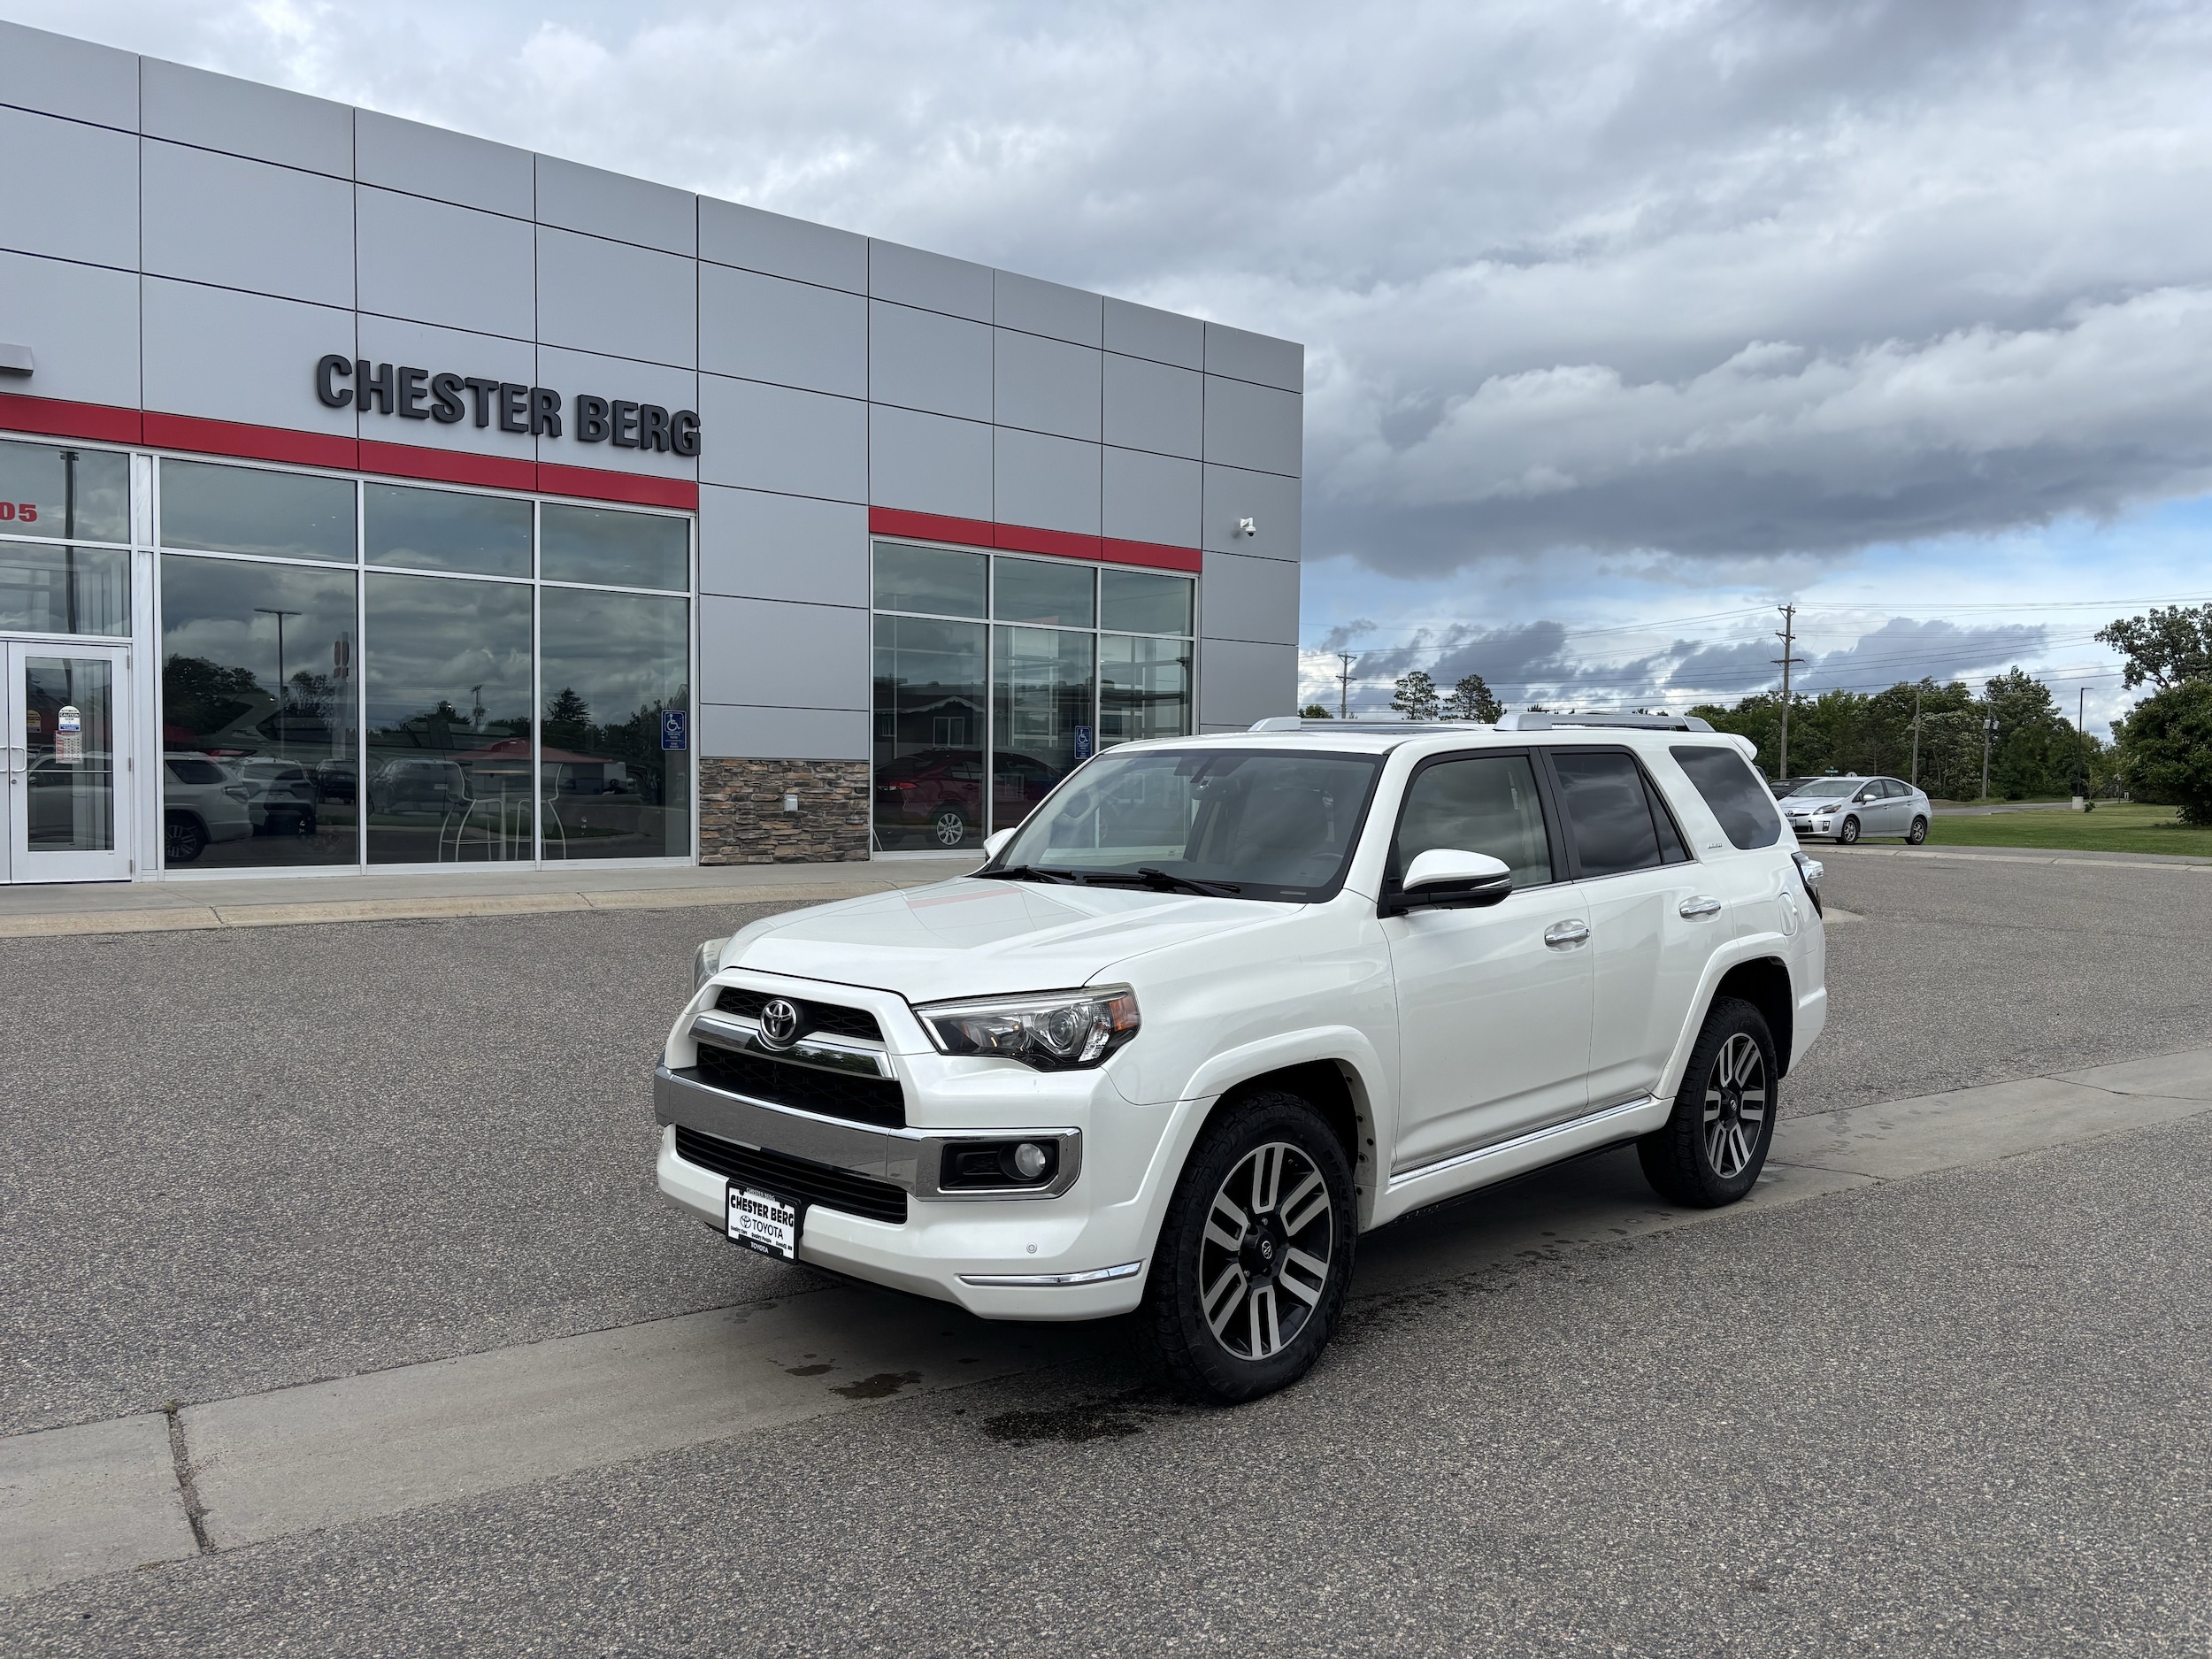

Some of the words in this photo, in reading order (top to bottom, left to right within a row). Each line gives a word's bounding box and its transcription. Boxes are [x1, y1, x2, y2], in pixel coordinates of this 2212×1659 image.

[317, 354, 563, 438] CHESTER
[577, 395, 701, 457] BERG
[0, 502, 38, 522] 05
[731, 1194, 768, 1219] CHESTER
[771, 1206, 794, 1227] BERG
[752, 1218, 783, 1240] TOYOTA
[750, 1240, 769, 1254] TOYOTA
